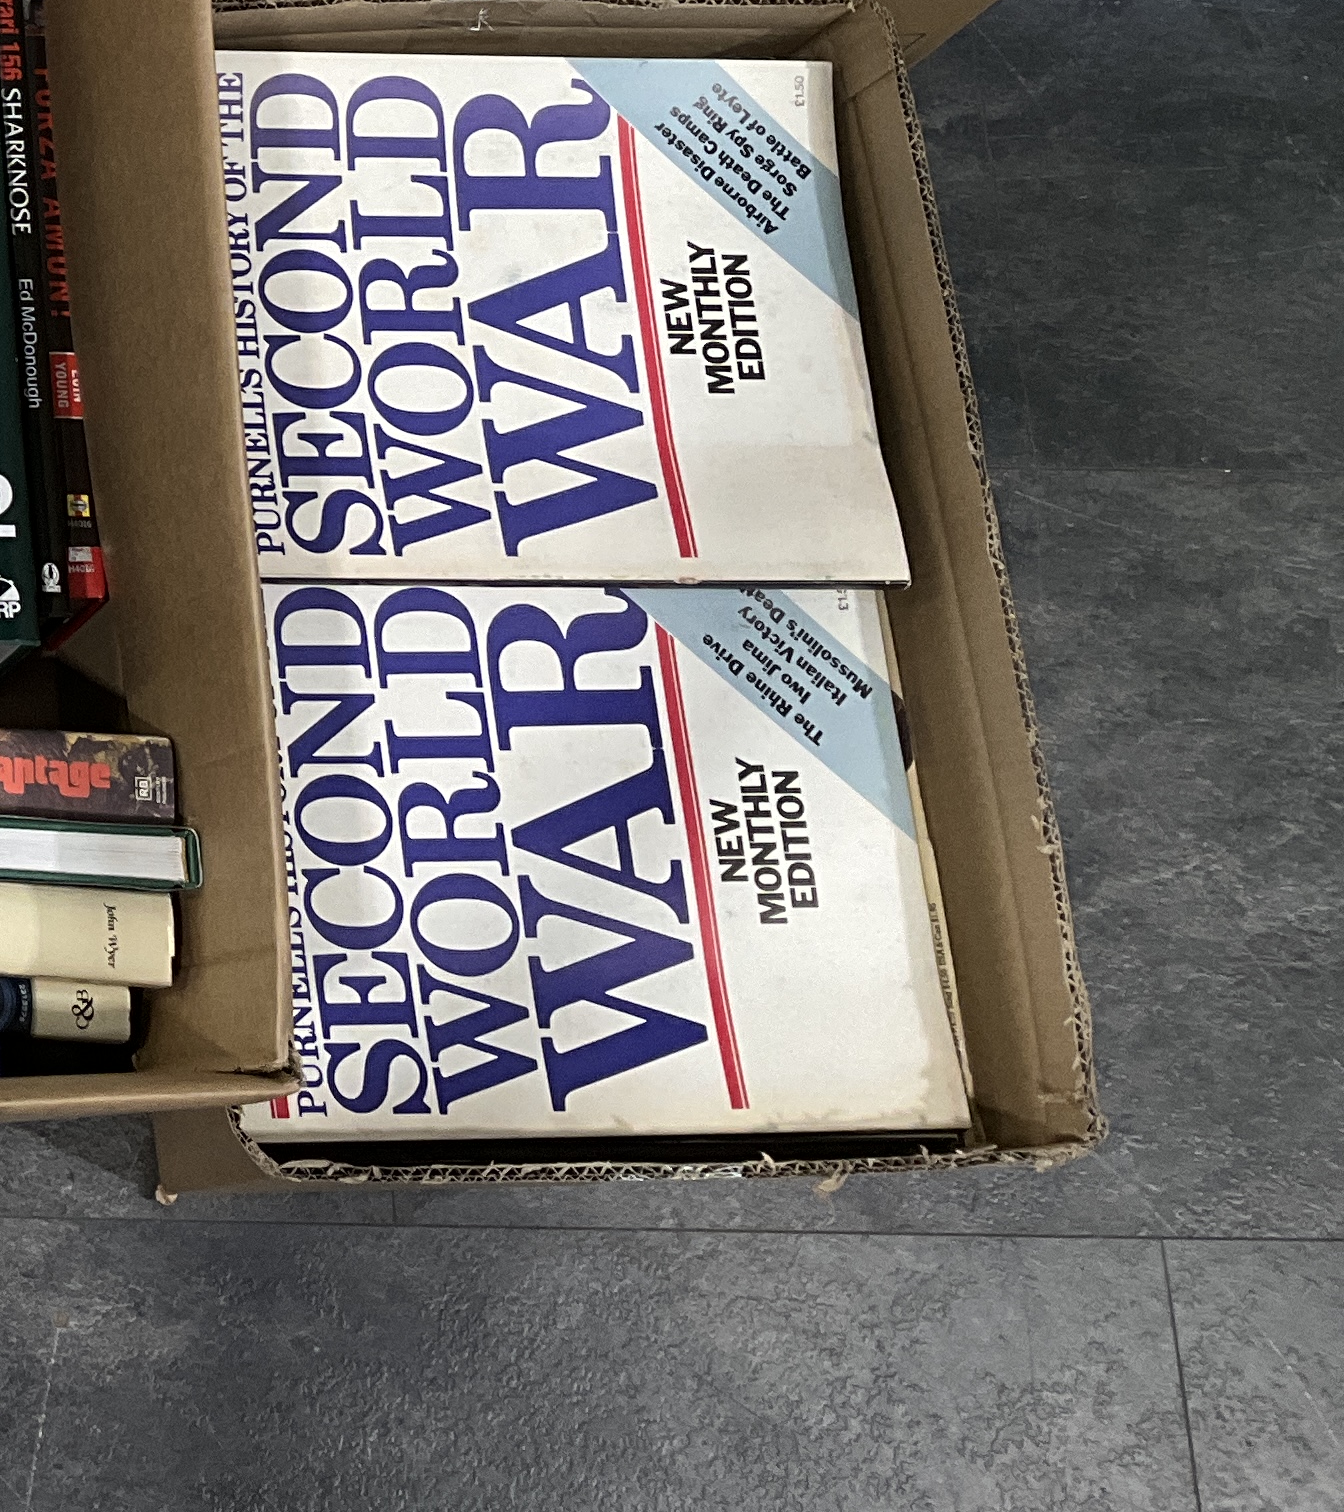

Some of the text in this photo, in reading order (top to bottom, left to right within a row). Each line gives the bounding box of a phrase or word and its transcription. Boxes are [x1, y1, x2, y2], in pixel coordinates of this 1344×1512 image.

[0, 88, 31, 236] SHARKNOSE
[250, 74, 387, 556] SECOND
[345, 76, 491, 556] WORLD
[454, 78, 658, 558] WAR
[661, 278, 697, 355] NEW
[686, 243, 735, 394] MONTHLY
[723, 254, 765, 382] EDITION
